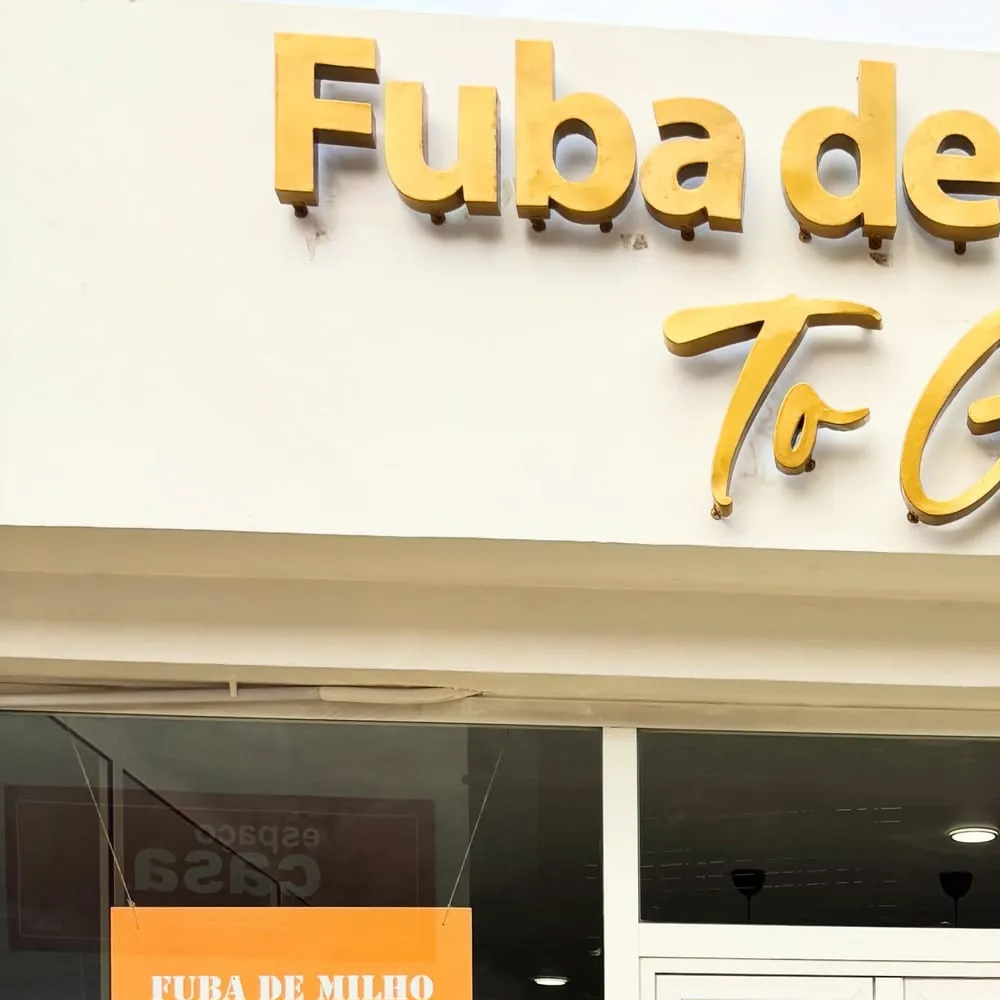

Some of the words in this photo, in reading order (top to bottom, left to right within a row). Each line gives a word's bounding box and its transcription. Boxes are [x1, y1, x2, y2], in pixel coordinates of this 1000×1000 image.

[274, 33, 746, 234] Fuba
[663, 294, 883, 518] To
[258, 975, 305, 1000] DE
[317, 975, 434, 1000] MILHO
